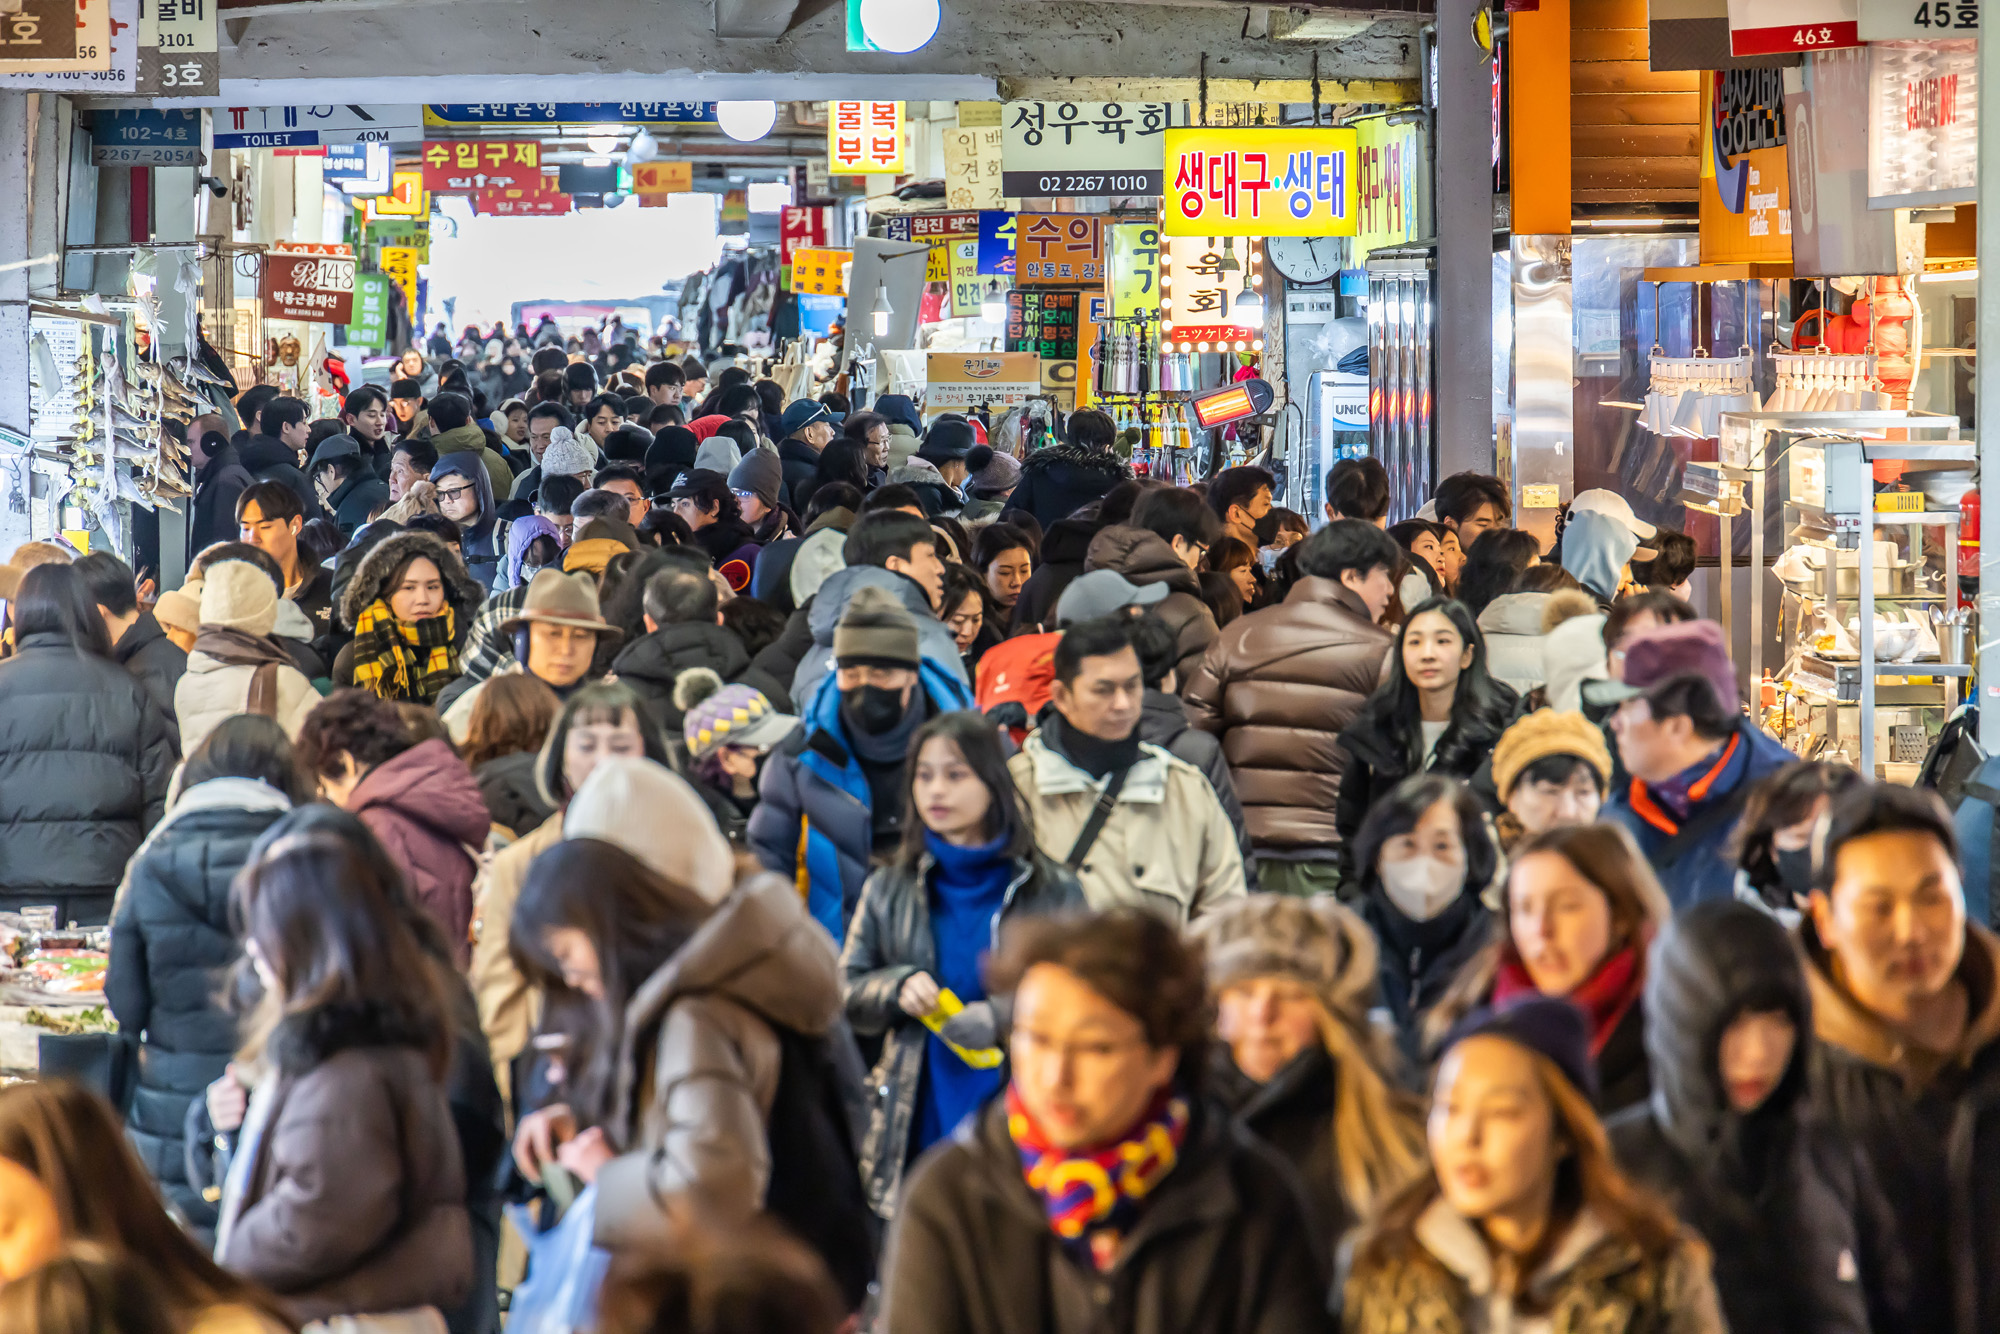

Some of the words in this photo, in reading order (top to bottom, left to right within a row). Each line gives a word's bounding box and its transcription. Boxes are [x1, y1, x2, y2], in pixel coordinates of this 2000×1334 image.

[1914, 1, 1979, 29] 45호
[1793, 27, 1835, 46] 46호
[79, 46, 97, 58] 56
[162, 61, 204, 87] 3호
[1010, 102, 1172, 146] 성우육회
[119, 127, 188, 141] 102-4호
[242, 134, 292, 147] TOILET
[356, 130, 389, 143] 40M
[98, 149, 194, 162] 2267-2054
[426, 142, 538, 169] 수입구제
[1039, 176, 1061, 191] 02
[1065, 175, 1105, 191] 2267
[1109, 174, 1148, 191] 1010
[1174, 151, 1345, 219] 생대구·생태
[913, 216, 944, 234] 원진
[995, 216, 1017, 251] 수
[963, 244, 975, 257] 삼
[1277, 252, 1284, 262] 8
[1332, 252, 1339, 263] 4
[319, 262, 354, 289] 148
[1290, 265, 1297, 276] 7
[1304, 268, 1312, 279] 6
[1320, 264, 1328, 276] 5
[1185, 237, 1228, 319] 육회
[1335, 404, 1369, 416] UNIC
